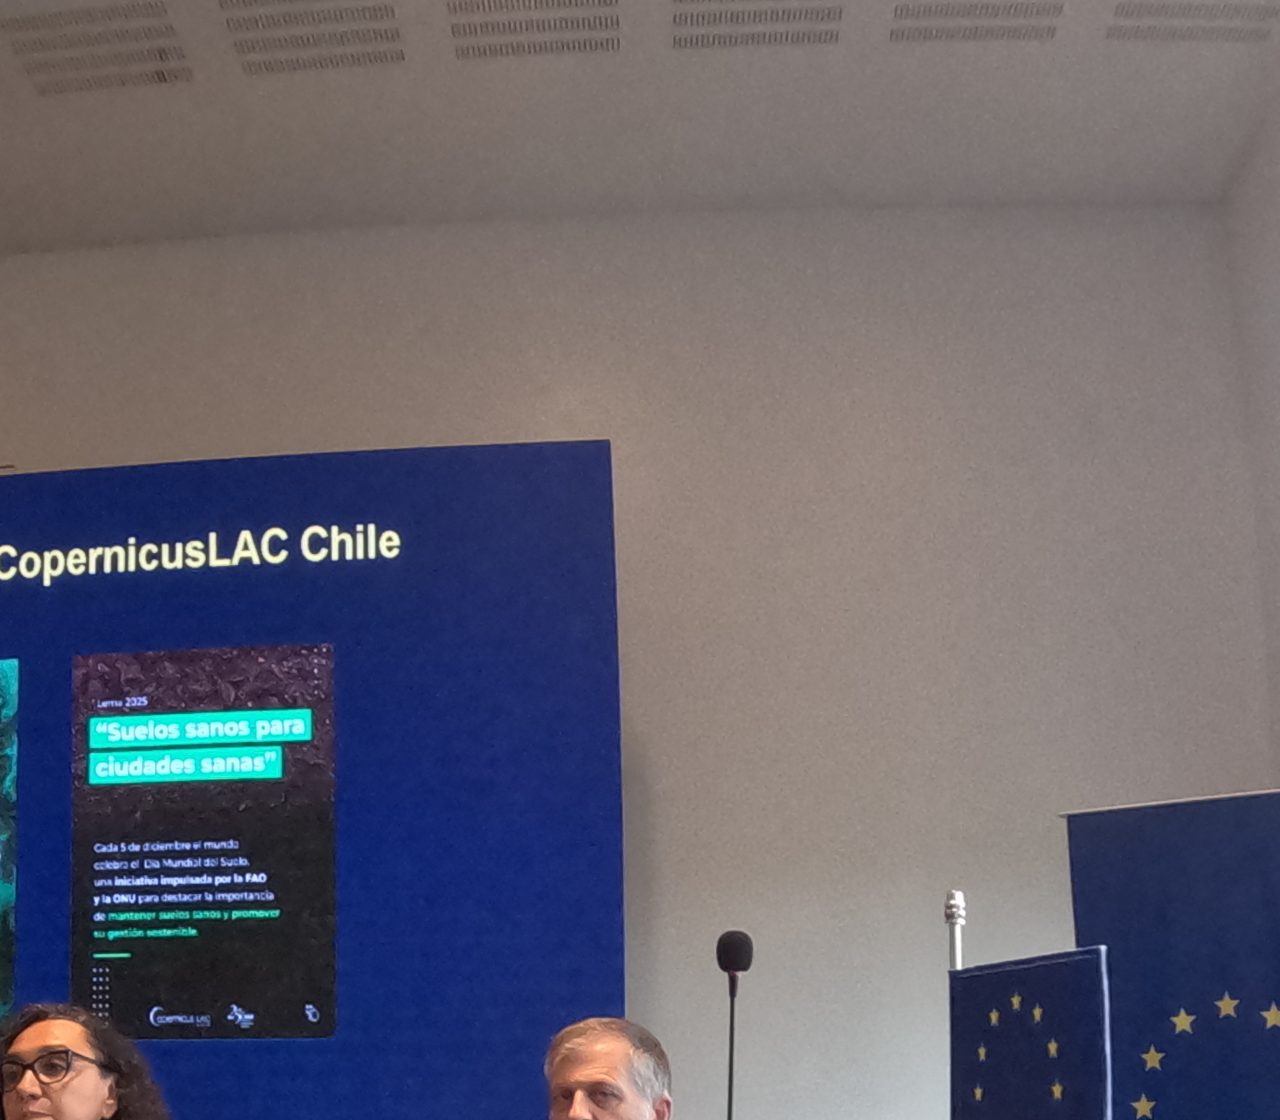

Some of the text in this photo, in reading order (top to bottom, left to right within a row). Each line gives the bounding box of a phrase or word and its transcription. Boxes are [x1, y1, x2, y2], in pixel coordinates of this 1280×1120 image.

[300, 523, 401, 562] Chile
[184, 718, 250, 740] sanos
[256, 717, 305, 741] para
[95, 755, 196, 777] ciudades
[94, 843, 119, 853] Cada
[128, 842, 141, 852] de
[114, 876, 159, 886] iniciativa
[160, 874, 213, 887] impulsada
[214, 875, 232, 886] por
[233, 873, 244, 883] la
[245, 872, 267, 883] FAO
[102, 894, 111, 904] la
[112, 893, 137, 904] ONU
[138, 894, 160, 905] para
[93, 912, 107, 921] de
